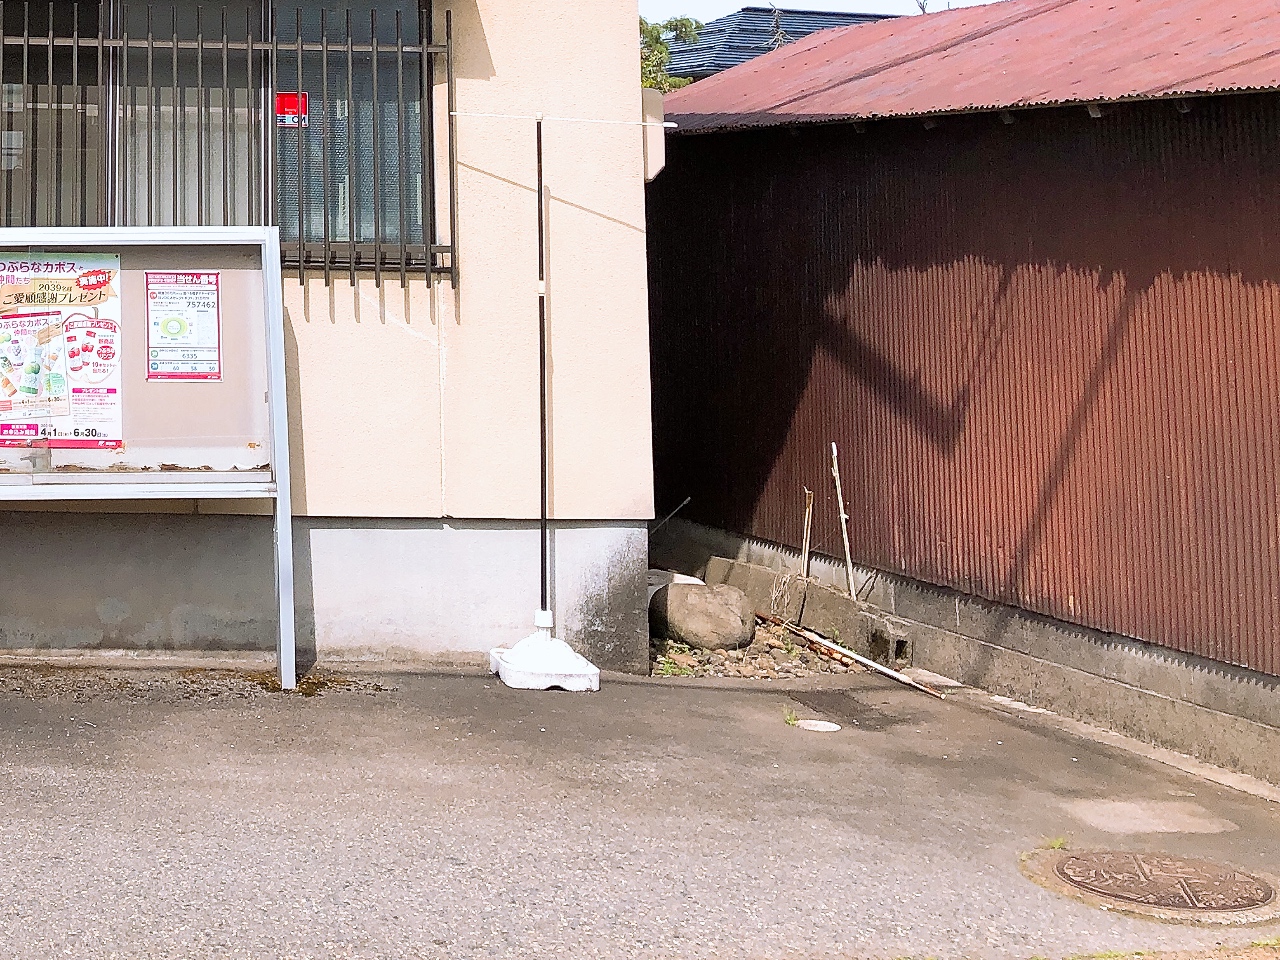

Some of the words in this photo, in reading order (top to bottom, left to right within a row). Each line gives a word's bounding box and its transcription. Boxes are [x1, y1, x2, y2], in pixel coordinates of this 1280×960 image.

[3, 291, 107, 305] ご愛顧感謝プレゼント
